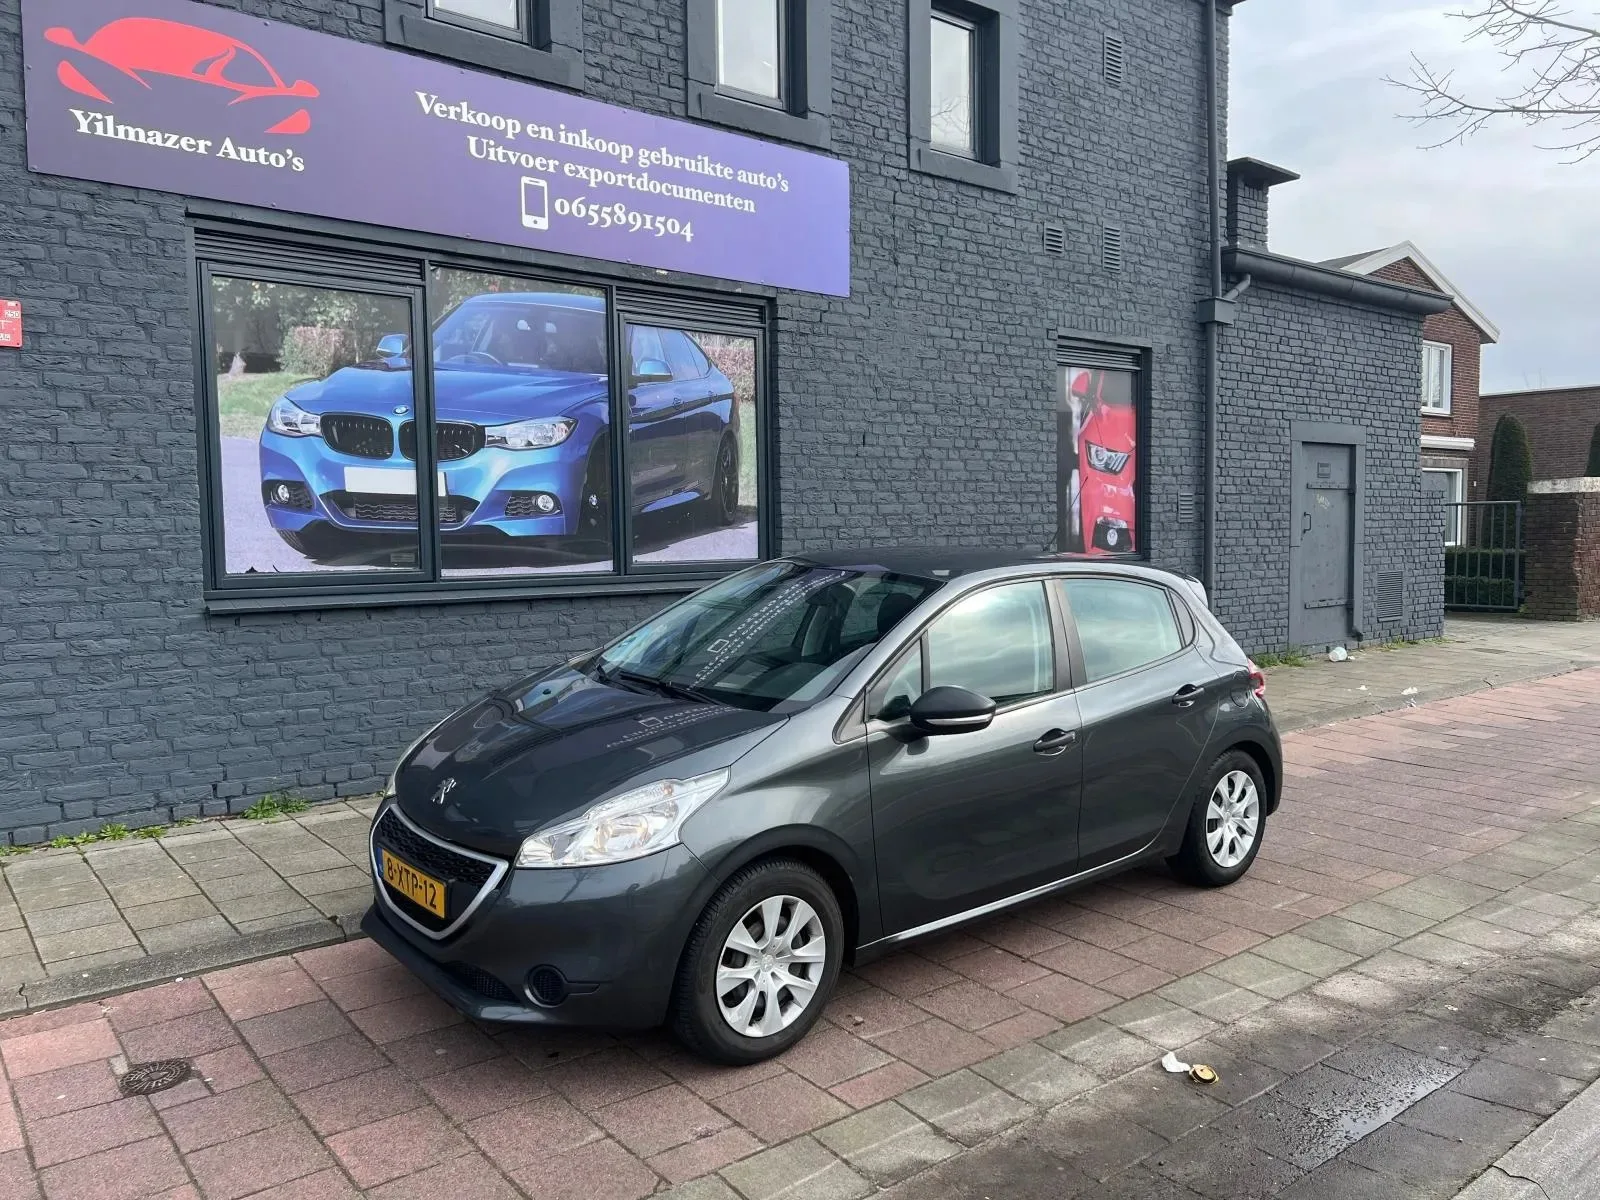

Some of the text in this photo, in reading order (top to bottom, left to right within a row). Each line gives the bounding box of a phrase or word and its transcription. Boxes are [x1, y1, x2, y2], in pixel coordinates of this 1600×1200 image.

[70, 109, 305, 172] Yilmazer Auto's
[415, 91, 789, 193] Verkoop en inkoop gebruikte auto's
[468, 135, 756, 213] Uitvoer exportdocumenten
[554, 197, 694, 243] 0655891504
[387, 858, 437, 910] 8-XTP-12
